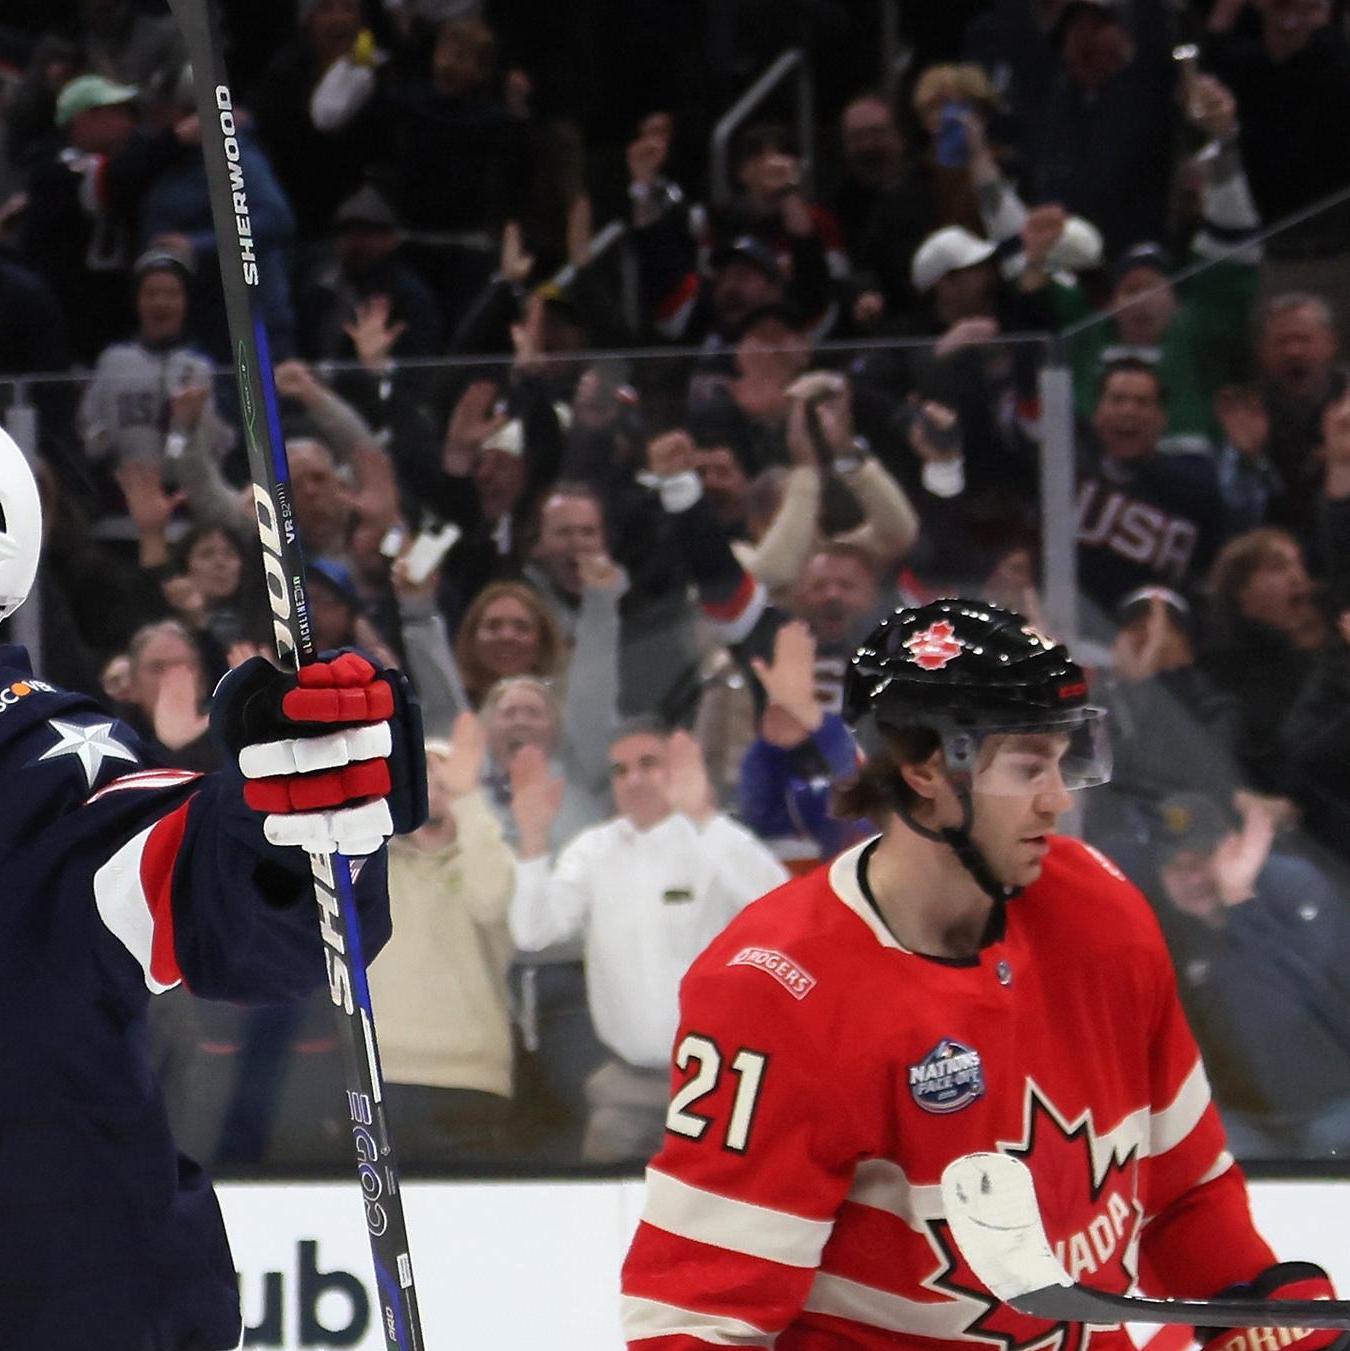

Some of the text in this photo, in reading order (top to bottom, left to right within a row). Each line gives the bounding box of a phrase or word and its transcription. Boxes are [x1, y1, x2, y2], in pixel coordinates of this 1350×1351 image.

[216, 84, 259, 286] SHERWOOD
[1072, 480, 1200, 577] USA
[664, 1033, 768, 1154] 21
